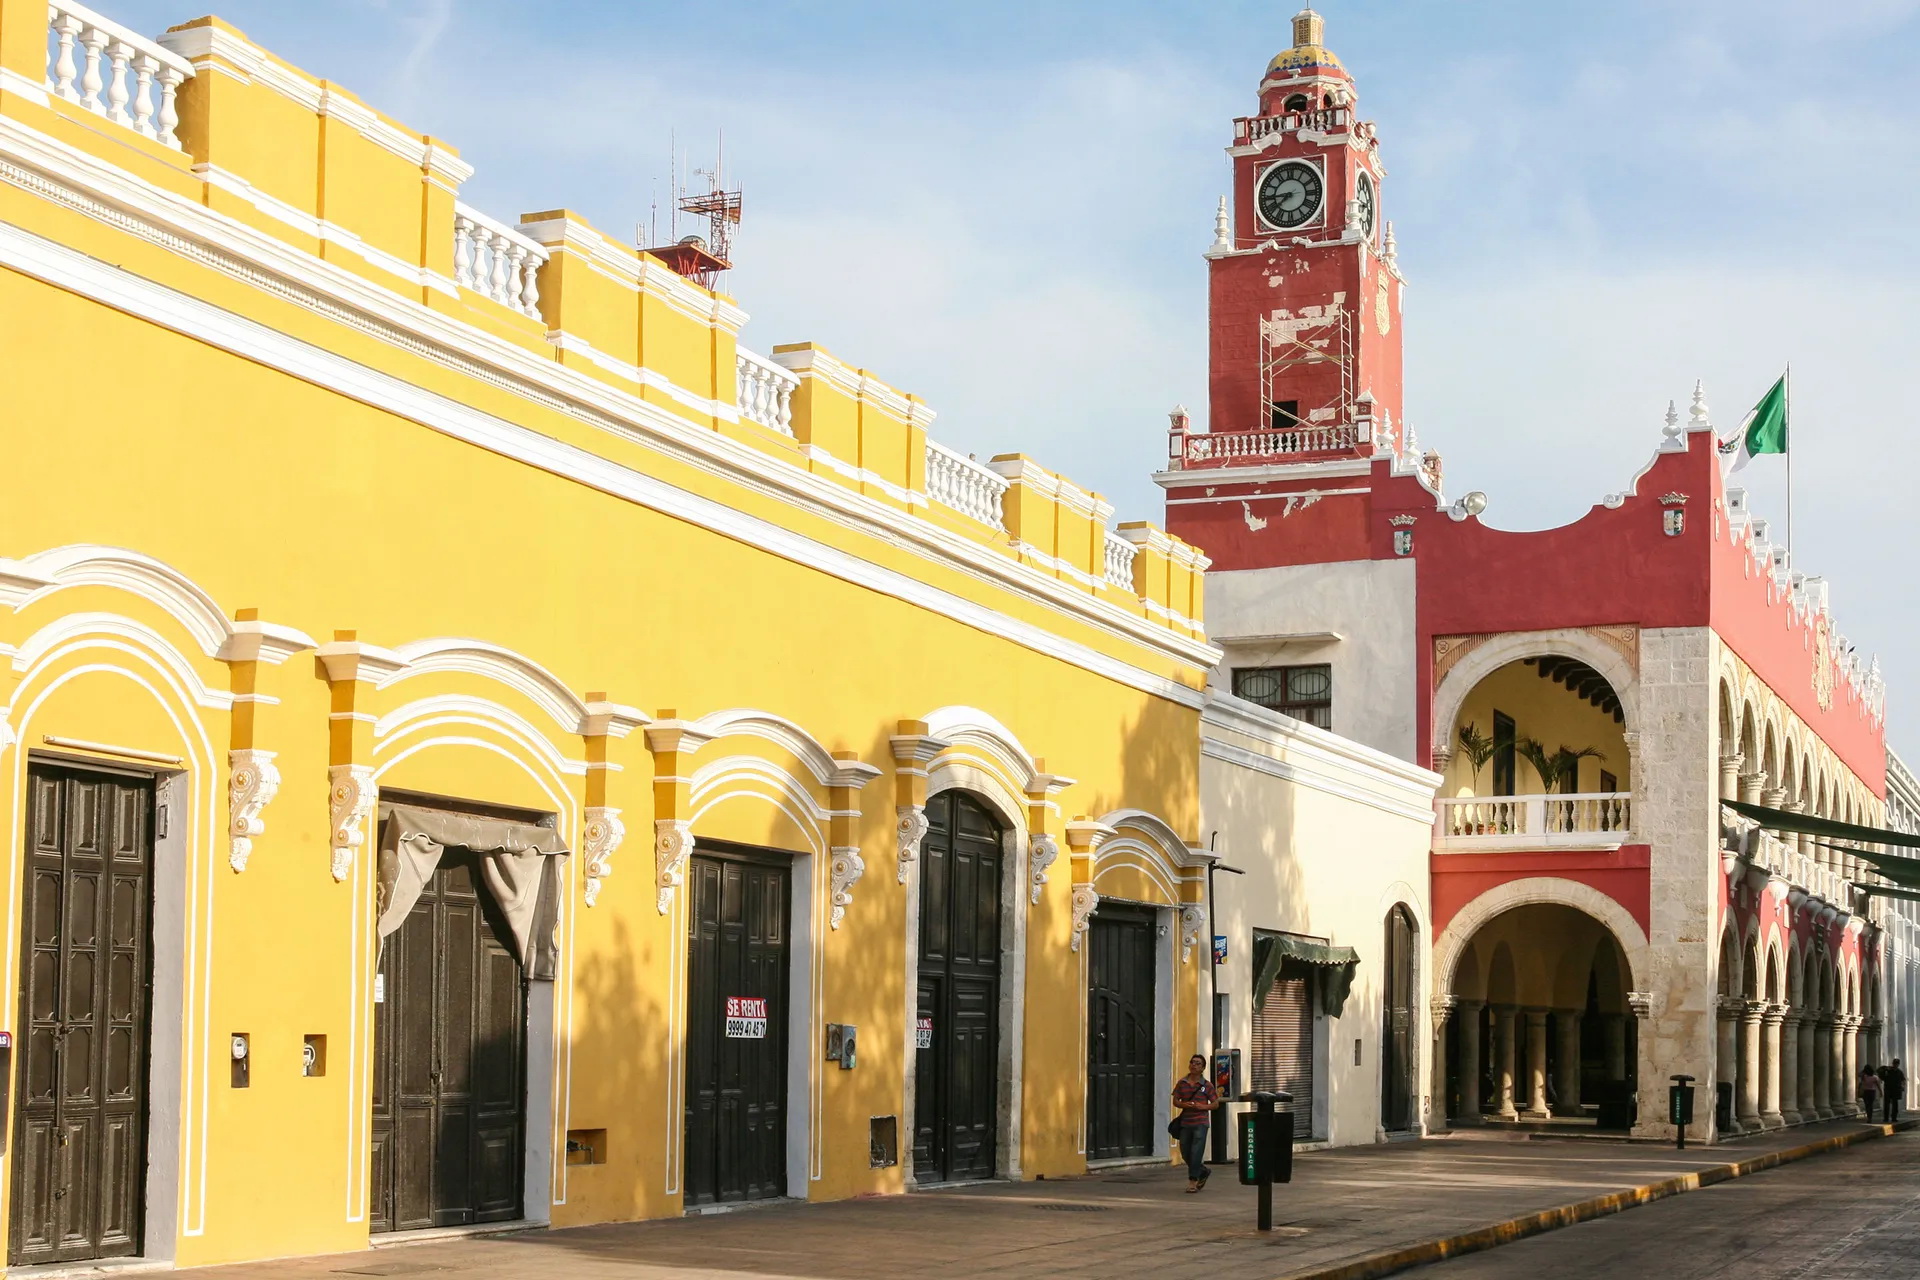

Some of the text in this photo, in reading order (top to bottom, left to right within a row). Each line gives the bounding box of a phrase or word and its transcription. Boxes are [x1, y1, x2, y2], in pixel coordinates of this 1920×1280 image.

[728, 998, 766, 1017] SE RENTA
[728, 1020, 744, 1036] 9999
